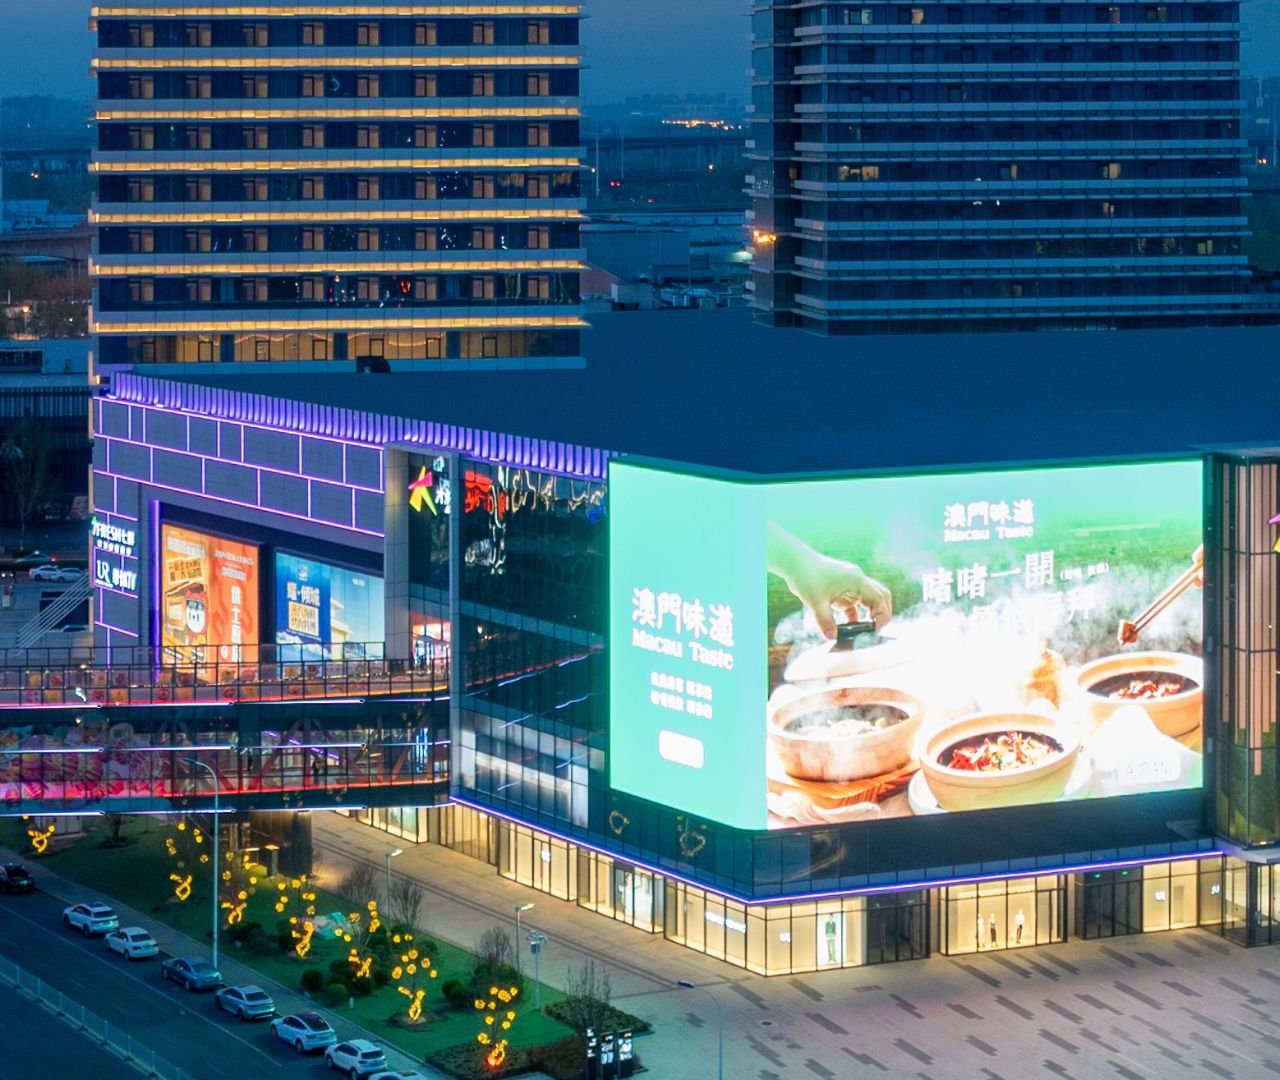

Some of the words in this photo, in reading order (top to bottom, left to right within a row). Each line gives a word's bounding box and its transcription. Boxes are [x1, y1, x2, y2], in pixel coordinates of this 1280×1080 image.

[944, 498, 1034, 528] 澳門味道
[632, 587, 734, 647] 澳門味道
[632, 628, 683, 658] Macau
[688, 641, 734, 670] Taste
